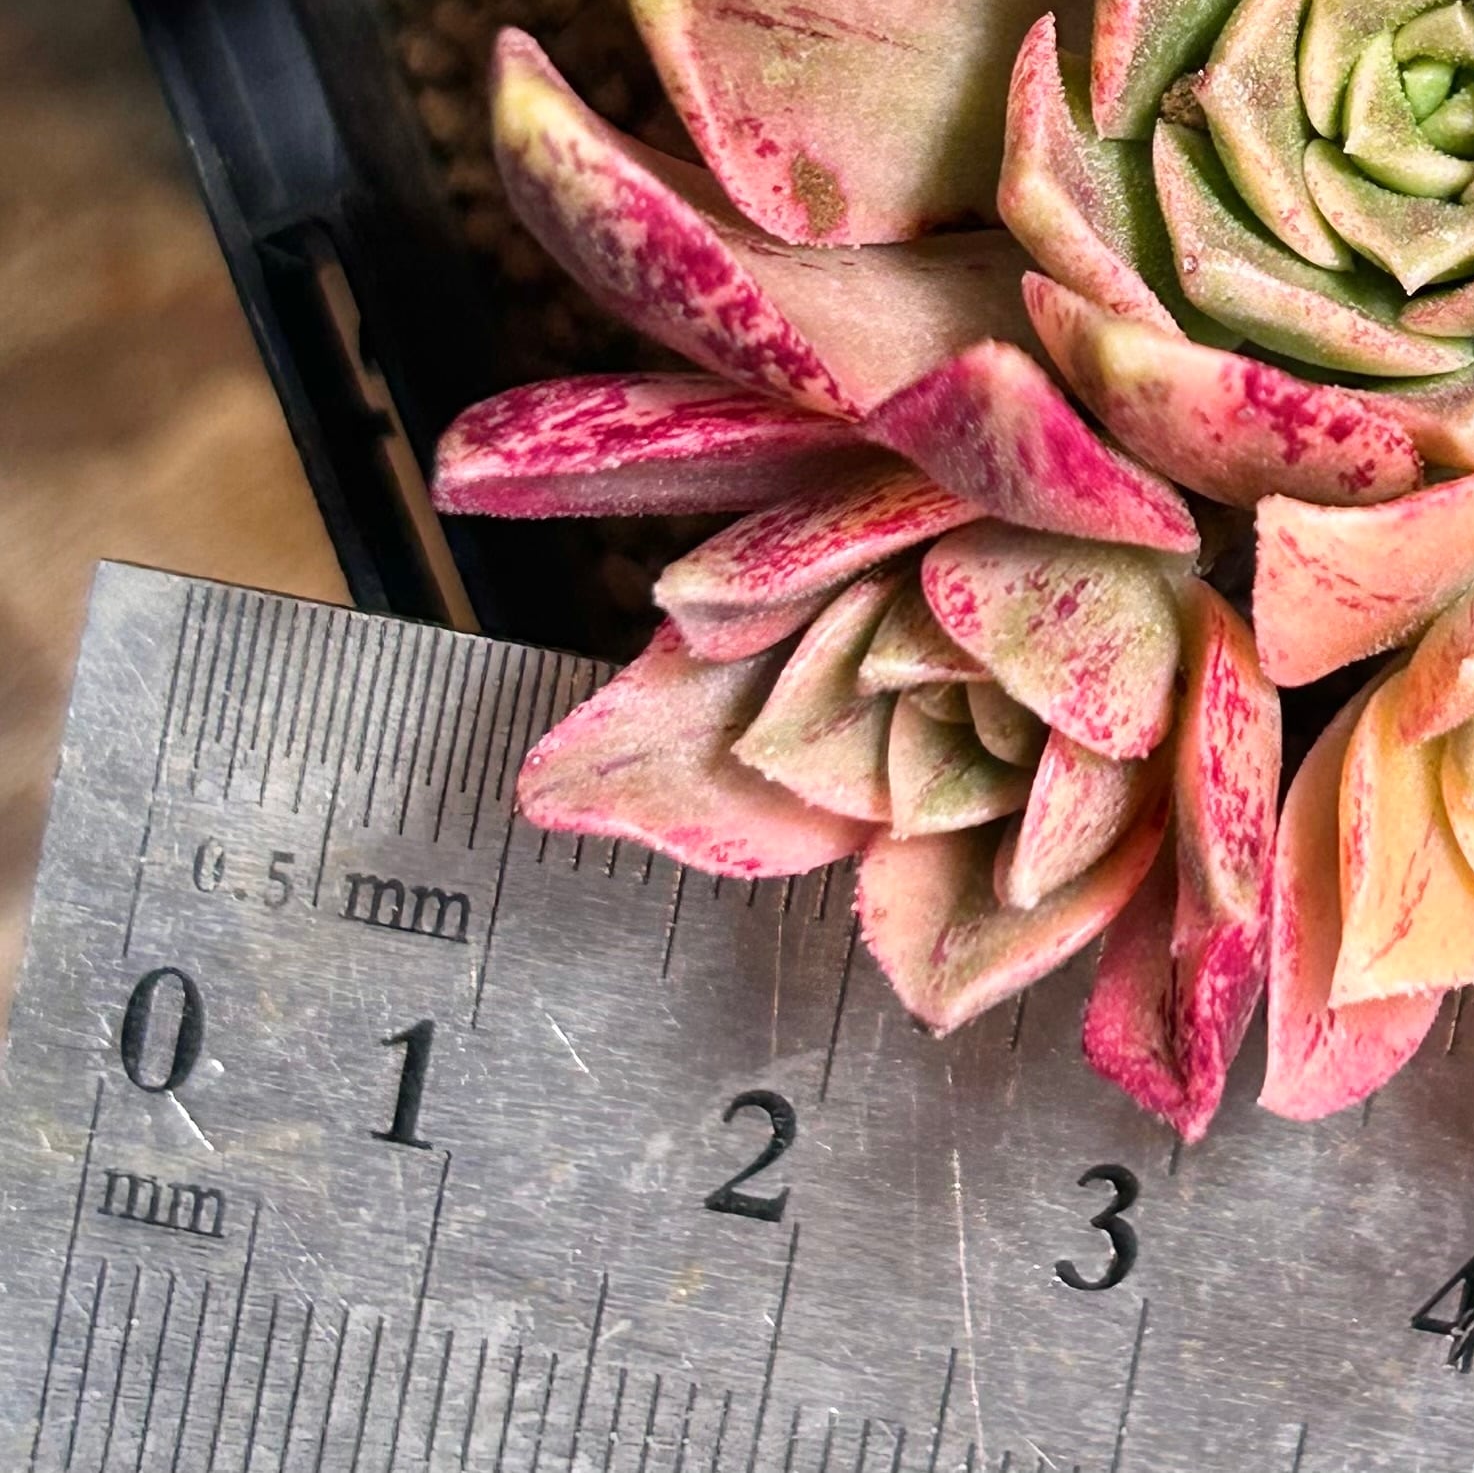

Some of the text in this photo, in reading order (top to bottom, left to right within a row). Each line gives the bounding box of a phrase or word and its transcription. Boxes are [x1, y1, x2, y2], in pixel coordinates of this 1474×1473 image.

[193, 836, 473, 943] 0.5 mm
[121, 966, 205, 1093] 0
[371, 1019, 435, 1150] 1
[704, 1089, 797, 1222] 2
[1055, 1163, 1140, 1291] 3
[97, 1168, 226, 1239] mm
